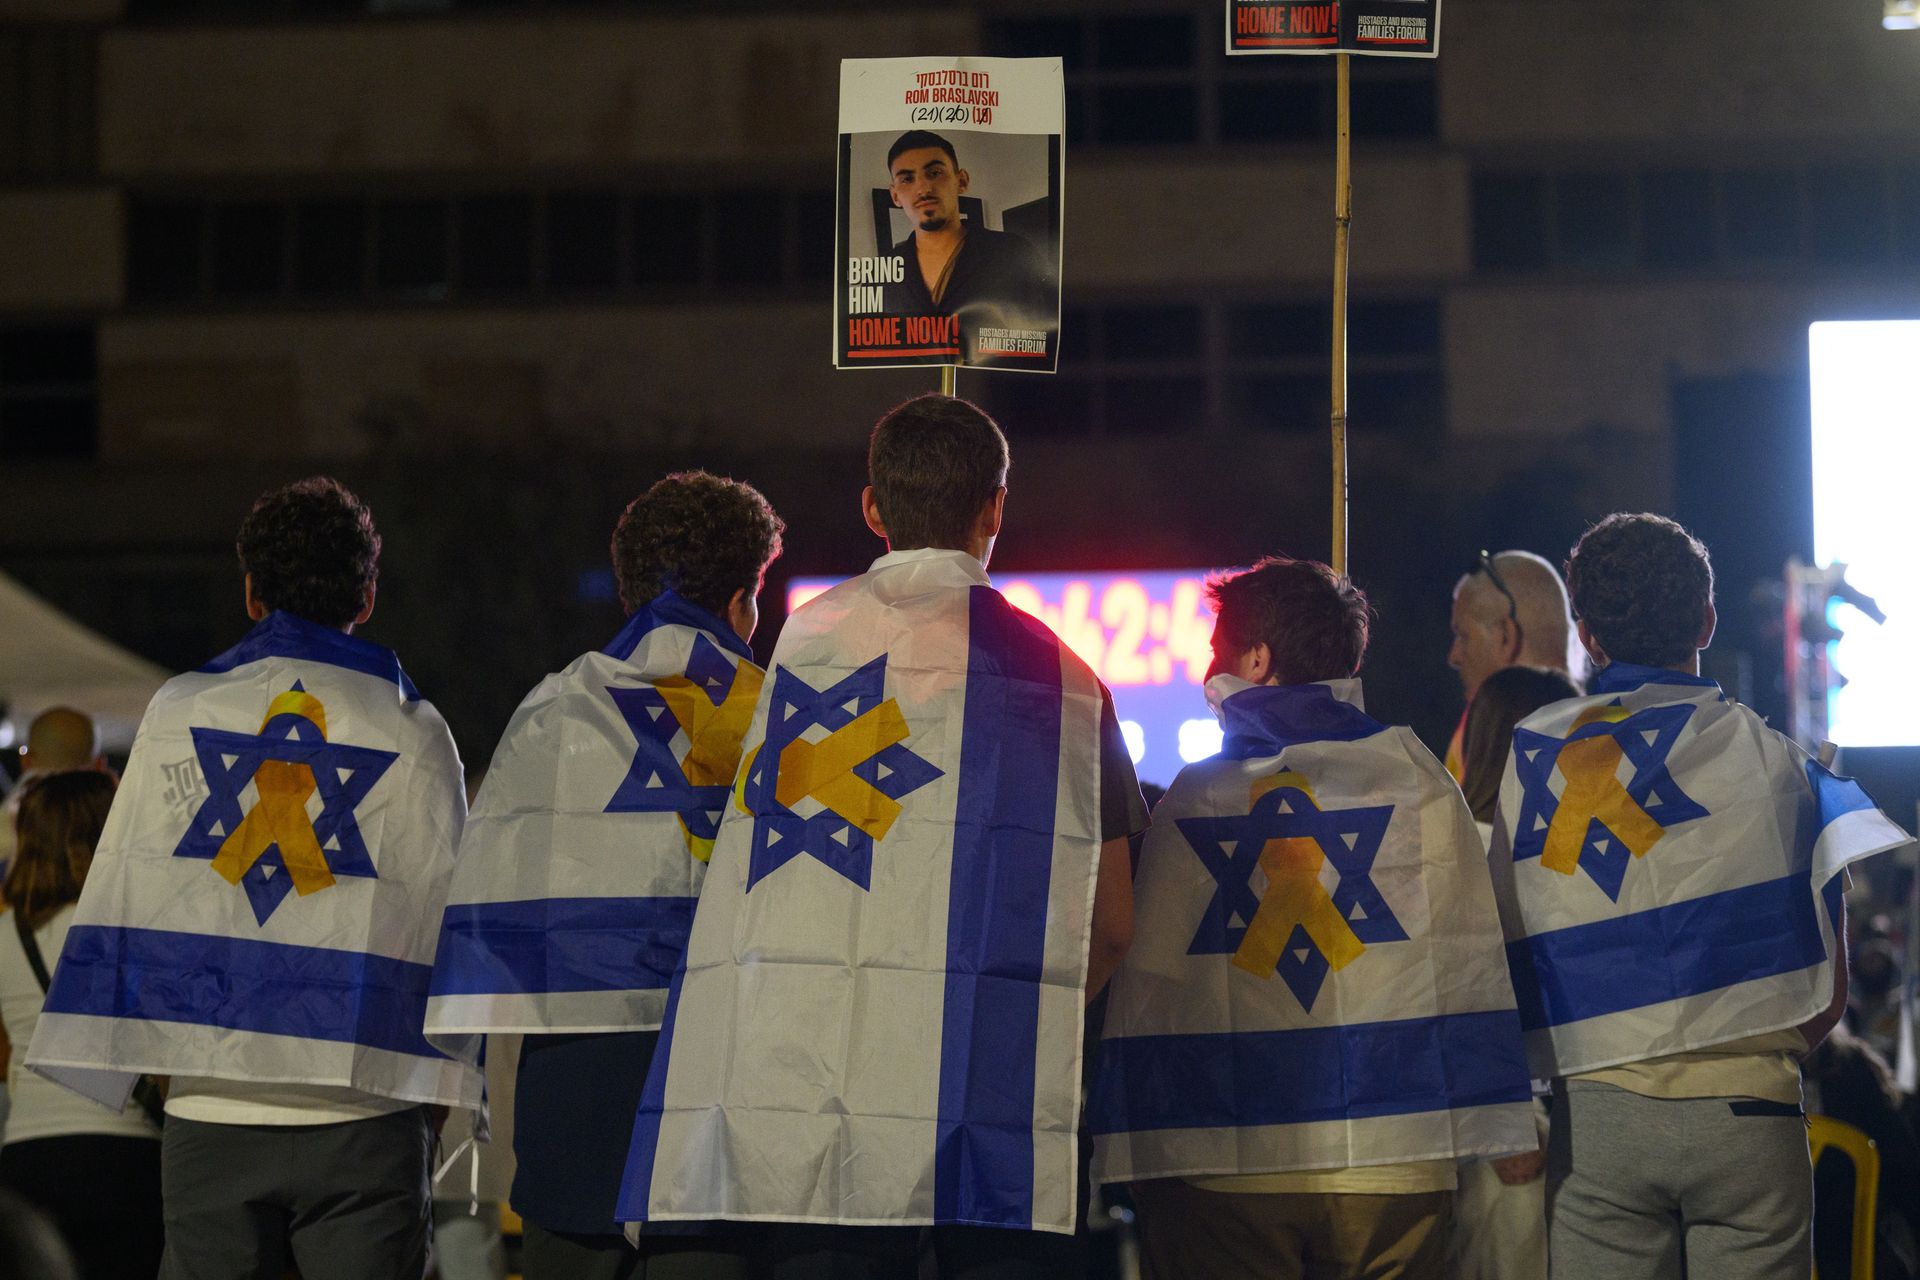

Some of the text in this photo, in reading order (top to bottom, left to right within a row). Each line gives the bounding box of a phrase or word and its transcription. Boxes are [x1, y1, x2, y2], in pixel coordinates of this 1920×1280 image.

[1237, 1, 1338, 33] HOME NOW!
[1358, 15, 1427, 27] HOSTAGES AND MISSING
[1357, 25, 1426, 40] FAMILIES FORUM
[971, 72, 989, 88] רום
[905, 88, 999, 106] ROM BRASLAVSKI
[849, 256, 904, 284] BRING
[849, 286, 883, 315] HIM
[849, 313, 959, 346] HOME NOW!
[979, 328, 1047, 340] HOSTAGES AND MISSING
[979, 337, 1046, 353] FAMILIES FORUM
